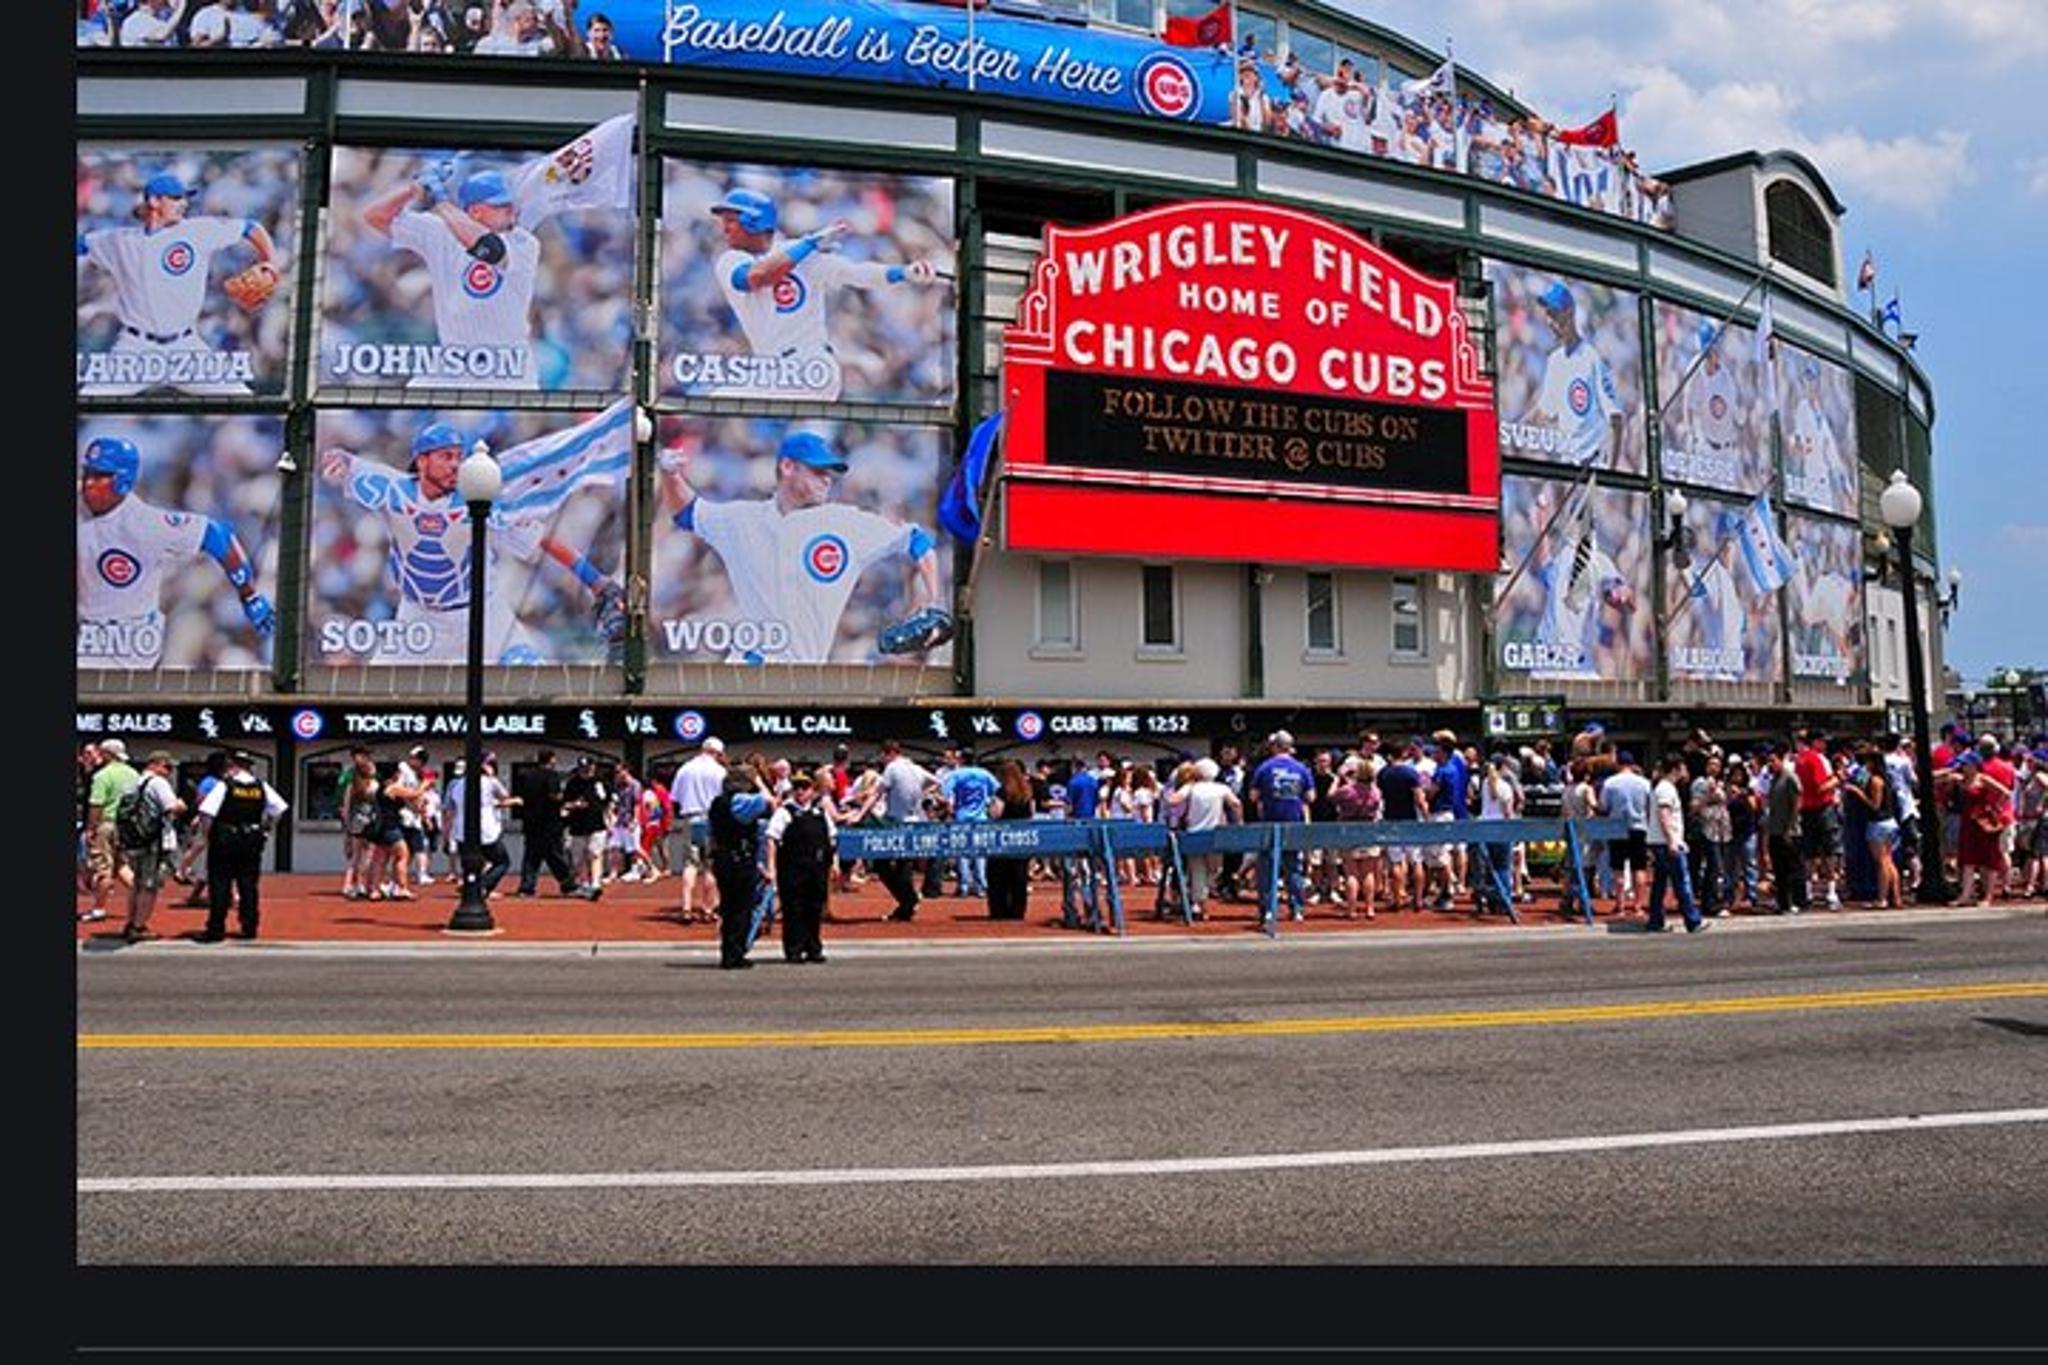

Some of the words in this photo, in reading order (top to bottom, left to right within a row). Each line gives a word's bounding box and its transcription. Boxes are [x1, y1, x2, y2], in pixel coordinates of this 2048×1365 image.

[661, 3, 852, 59] Baseball
[855, 27, 896, 62] is
[904, 25, 1021, 82] Better
[1031, 45, 1124, 94] Here
[1065, 222, 1289, 296] WRIGLEY
[1312, 237, 1443, 338] FIELD
[1179, 282, 1281, 320] HOME
[1306, 299, 1350, 328] OF
[333, 344, 526, 378] JOHNSON
[673, 353, 832, 389] CASTRO
[1064, 319, 1297, 384] CHICAGO
[1319, 347, 1447, 400] CUBS
[1103, 388, 1236, 424] FOLLOW
[1242, 402, 1299, 430] THE
[1304, 408, 1374, 437] CUBS
[1380, 415, 1420, 441] ON
[1284, 437, 1312, 471] @
[1316, 440, 1387, 471] CUBS
[320, 619, 434, 655] SOTO
[662, 619, 791, 652] WOOD
[108, 713, 172, 732] SALES
[344, 714, 428, 732] TICKETS
[431, 715, 545, 732] AVLABLE
[750, 715, 797, 733] WILL
[801, 715, 852, 733] CALL
[1050, 715, 1097, 732] CUBS
[1101, 715, 1139, 732] TIME
